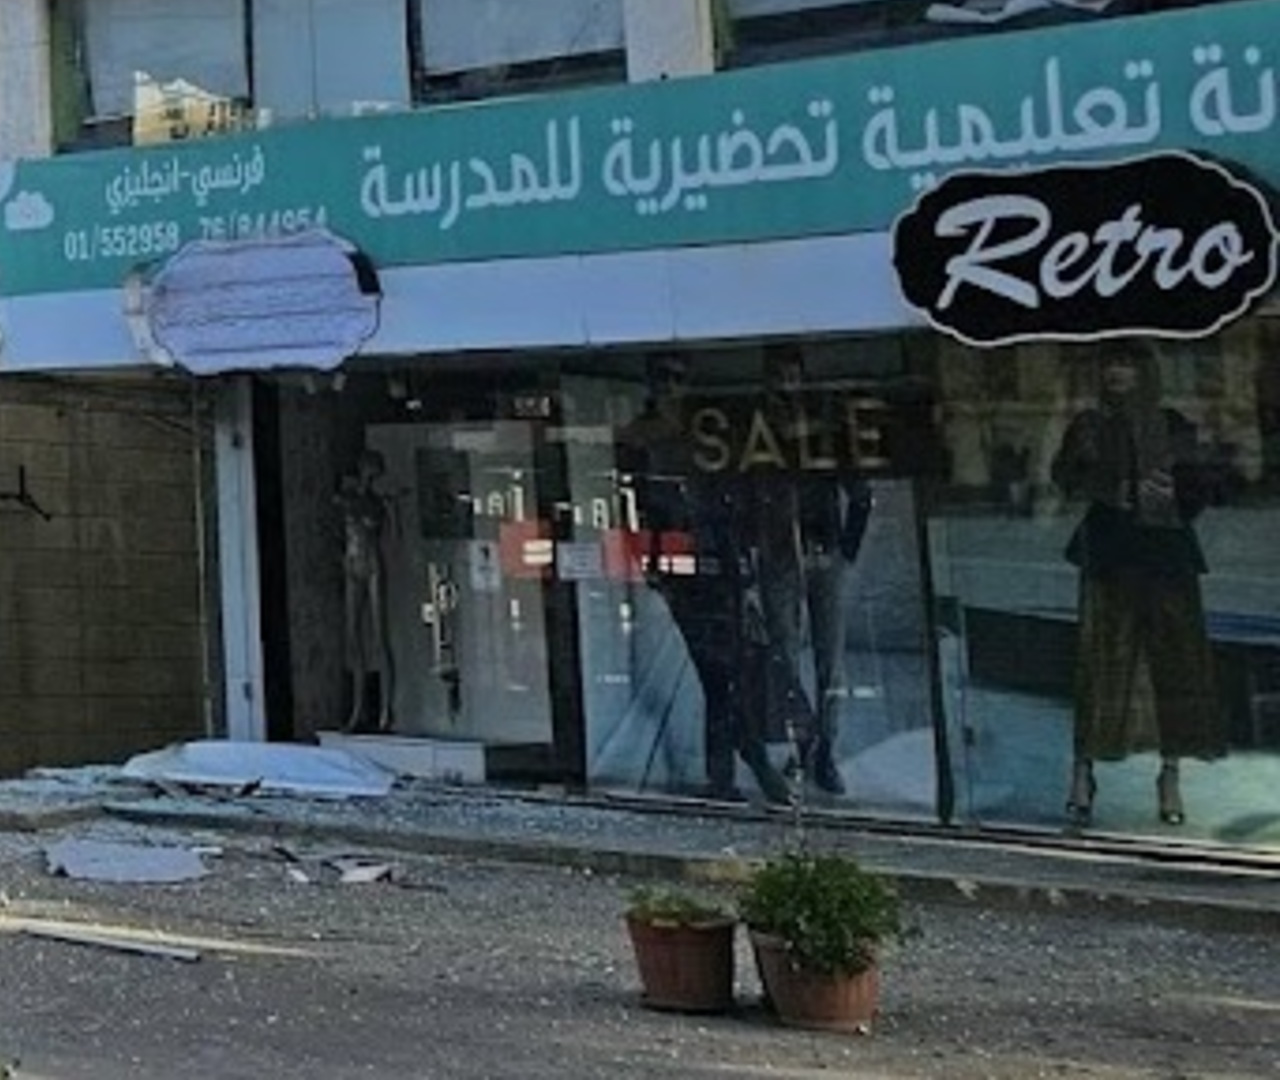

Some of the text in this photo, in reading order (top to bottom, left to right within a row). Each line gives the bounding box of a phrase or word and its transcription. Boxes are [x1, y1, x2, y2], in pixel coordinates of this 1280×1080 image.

[359, 117, 582, 231] للمدرسة
[602, 98, 839, 216] تحضيرية
[863, 56, 1160, 190] تعليمية
[63, 220, 180, 261] 01/552958
[935, 194, 1254, 313] Retro
[692, 396, 892, 472] SALE
